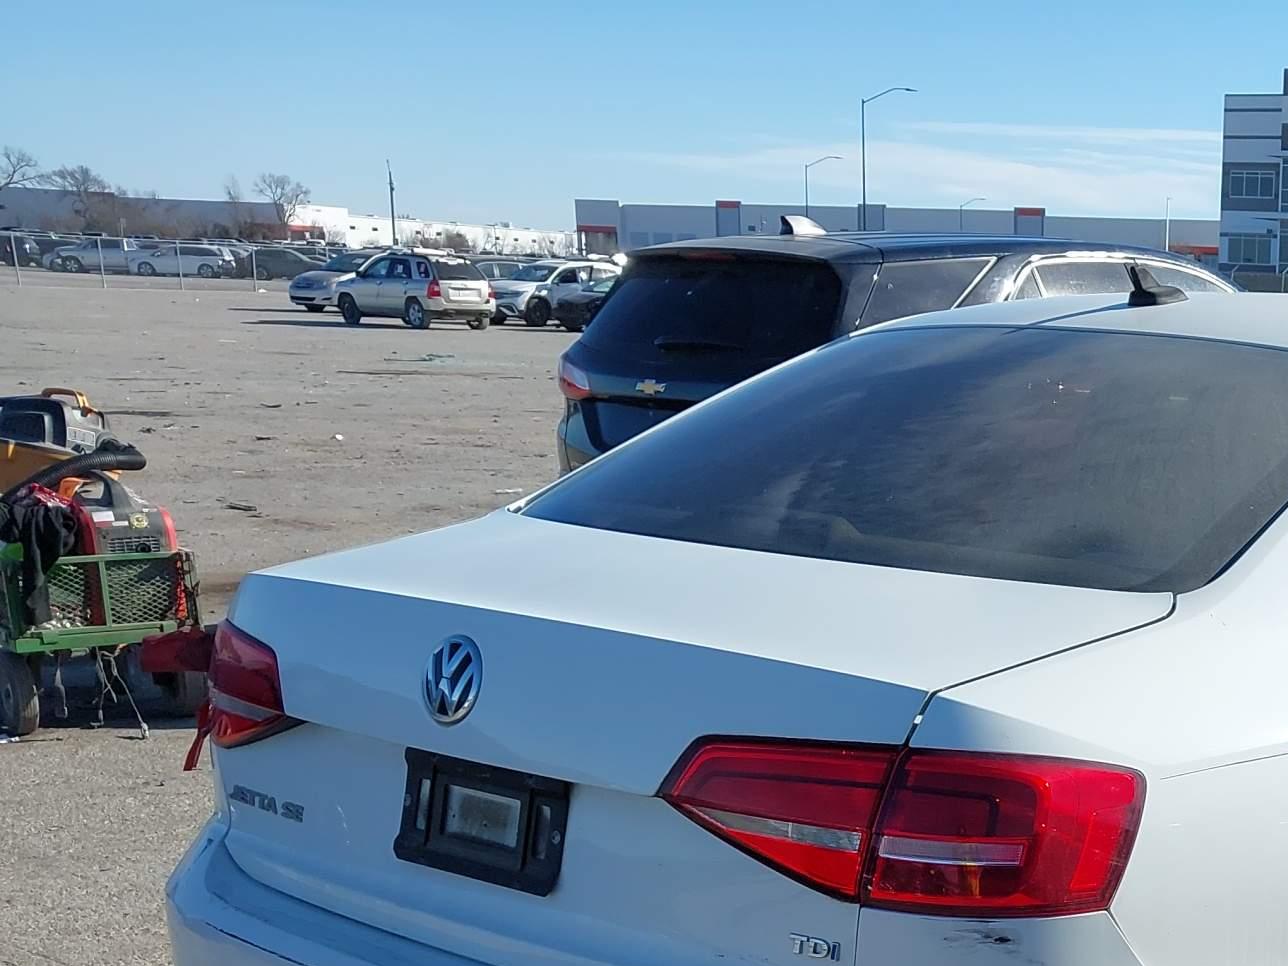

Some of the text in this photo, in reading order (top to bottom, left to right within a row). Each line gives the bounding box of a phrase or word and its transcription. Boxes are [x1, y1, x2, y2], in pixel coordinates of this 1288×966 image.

[230, 784, 305, 824] JETTA SE
[788, 931, 841, 962] TDI
